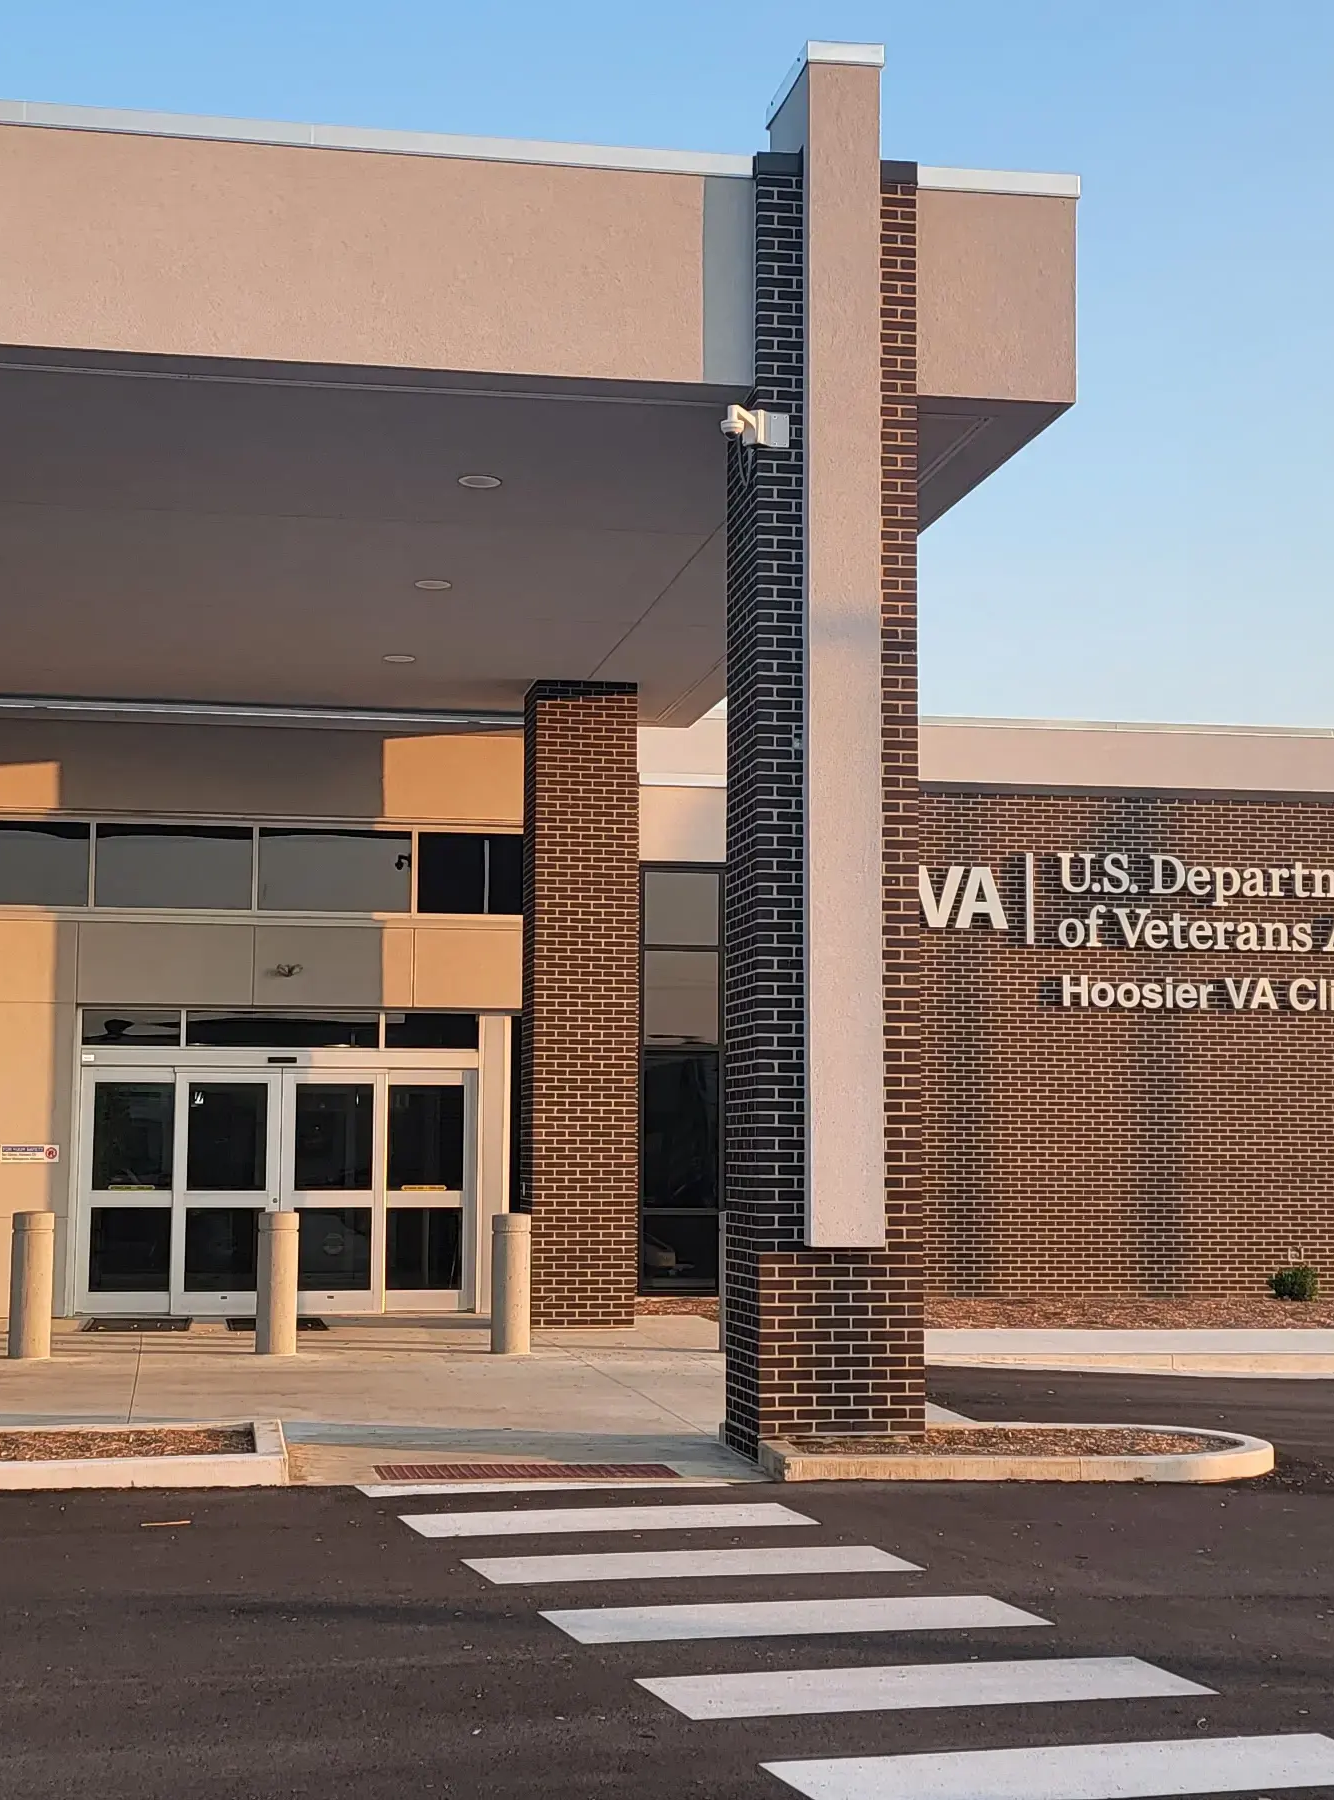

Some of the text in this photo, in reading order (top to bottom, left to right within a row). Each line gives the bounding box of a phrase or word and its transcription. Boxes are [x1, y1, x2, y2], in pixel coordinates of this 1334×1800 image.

[1058, 852, 1137, 893] U.S.
[919, 865, 1009, 929] VA
[1058, 904, 1104, 948] of
[1113, 908, 1313, 952] Veterans
[1062, 975, 1214, 1009] Hoosier
[1224, 977, 1278, 1010] VA
